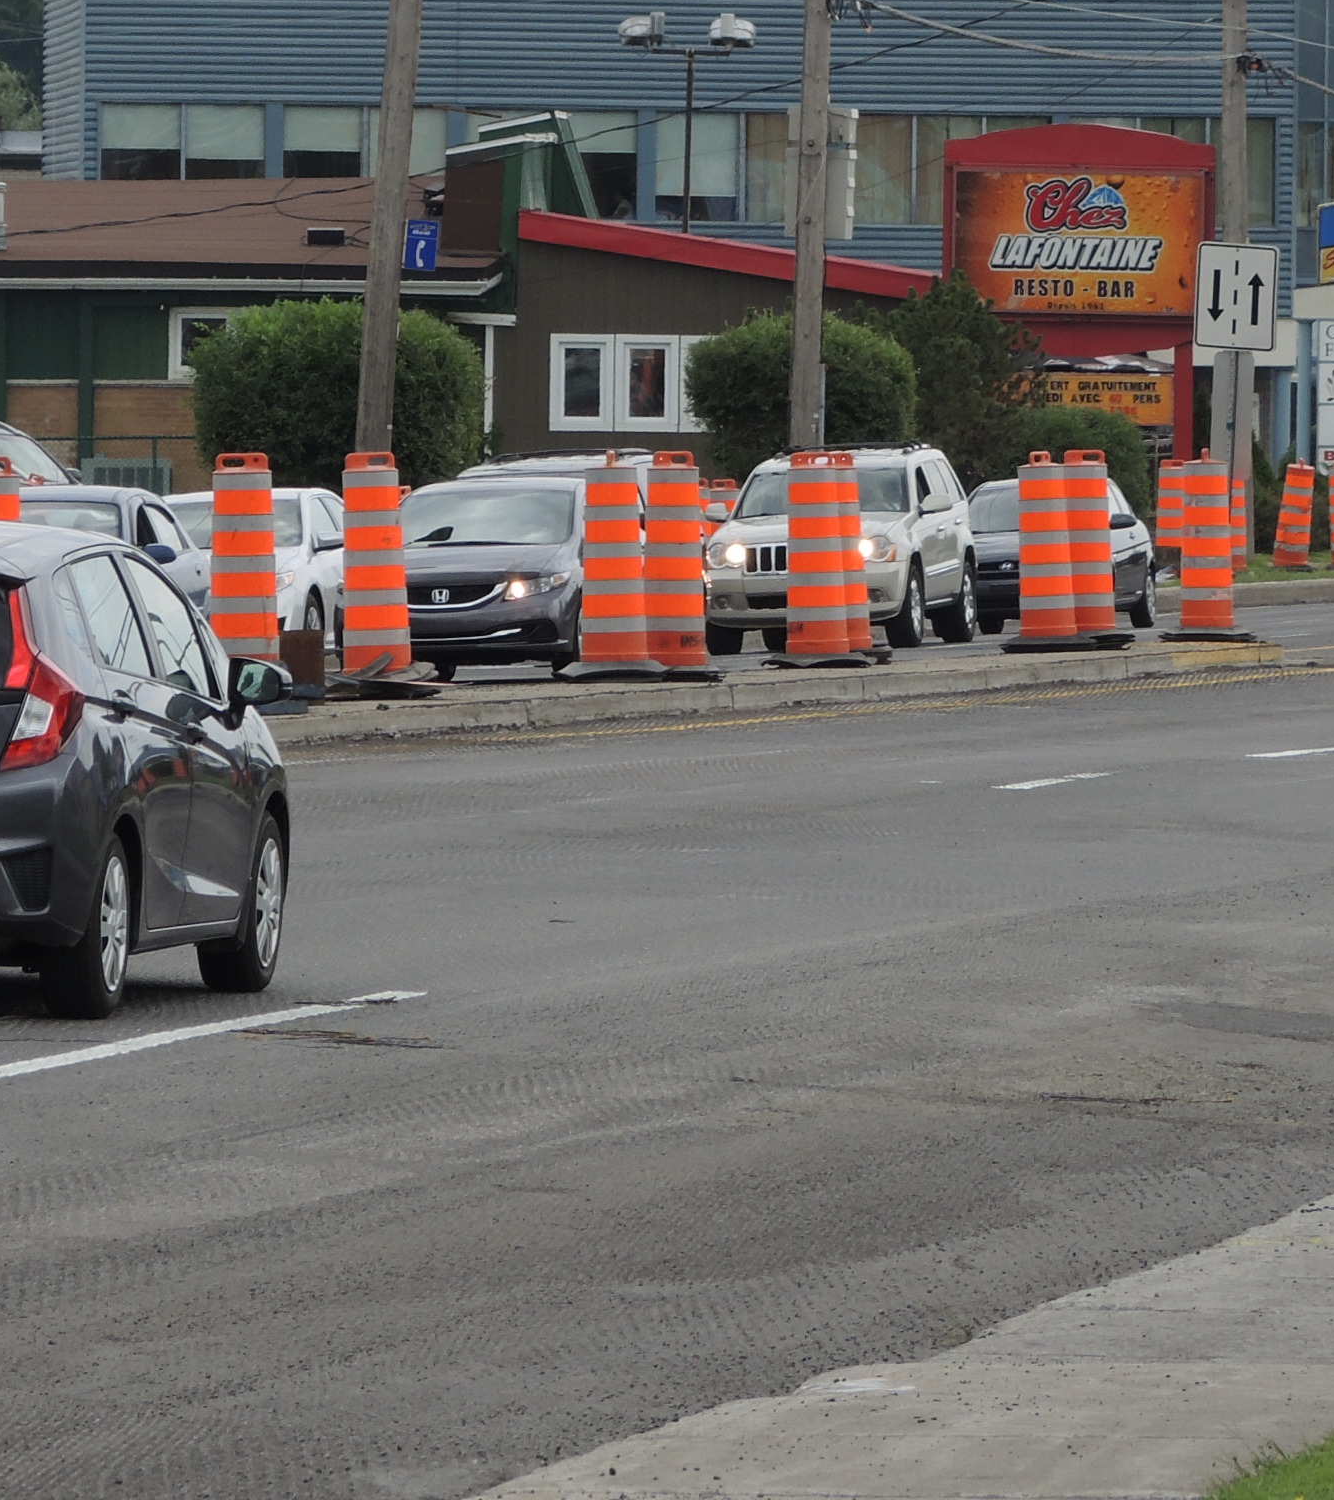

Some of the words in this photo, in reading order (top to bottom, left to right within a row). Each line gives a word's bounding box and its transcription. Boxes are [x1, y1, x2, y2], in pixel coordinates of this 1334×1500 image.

[1025, 176, 1128, 233] Chez
[988, 234, 1164, 274] LAFONTAINE
[1013, 278, 1074, 297] RESTO
[1096, 280, 1136, 298] BAR
[1078, 381, 1157, 391] GRATUITEMENT
[1132, 394, 1161, 404] PERS
